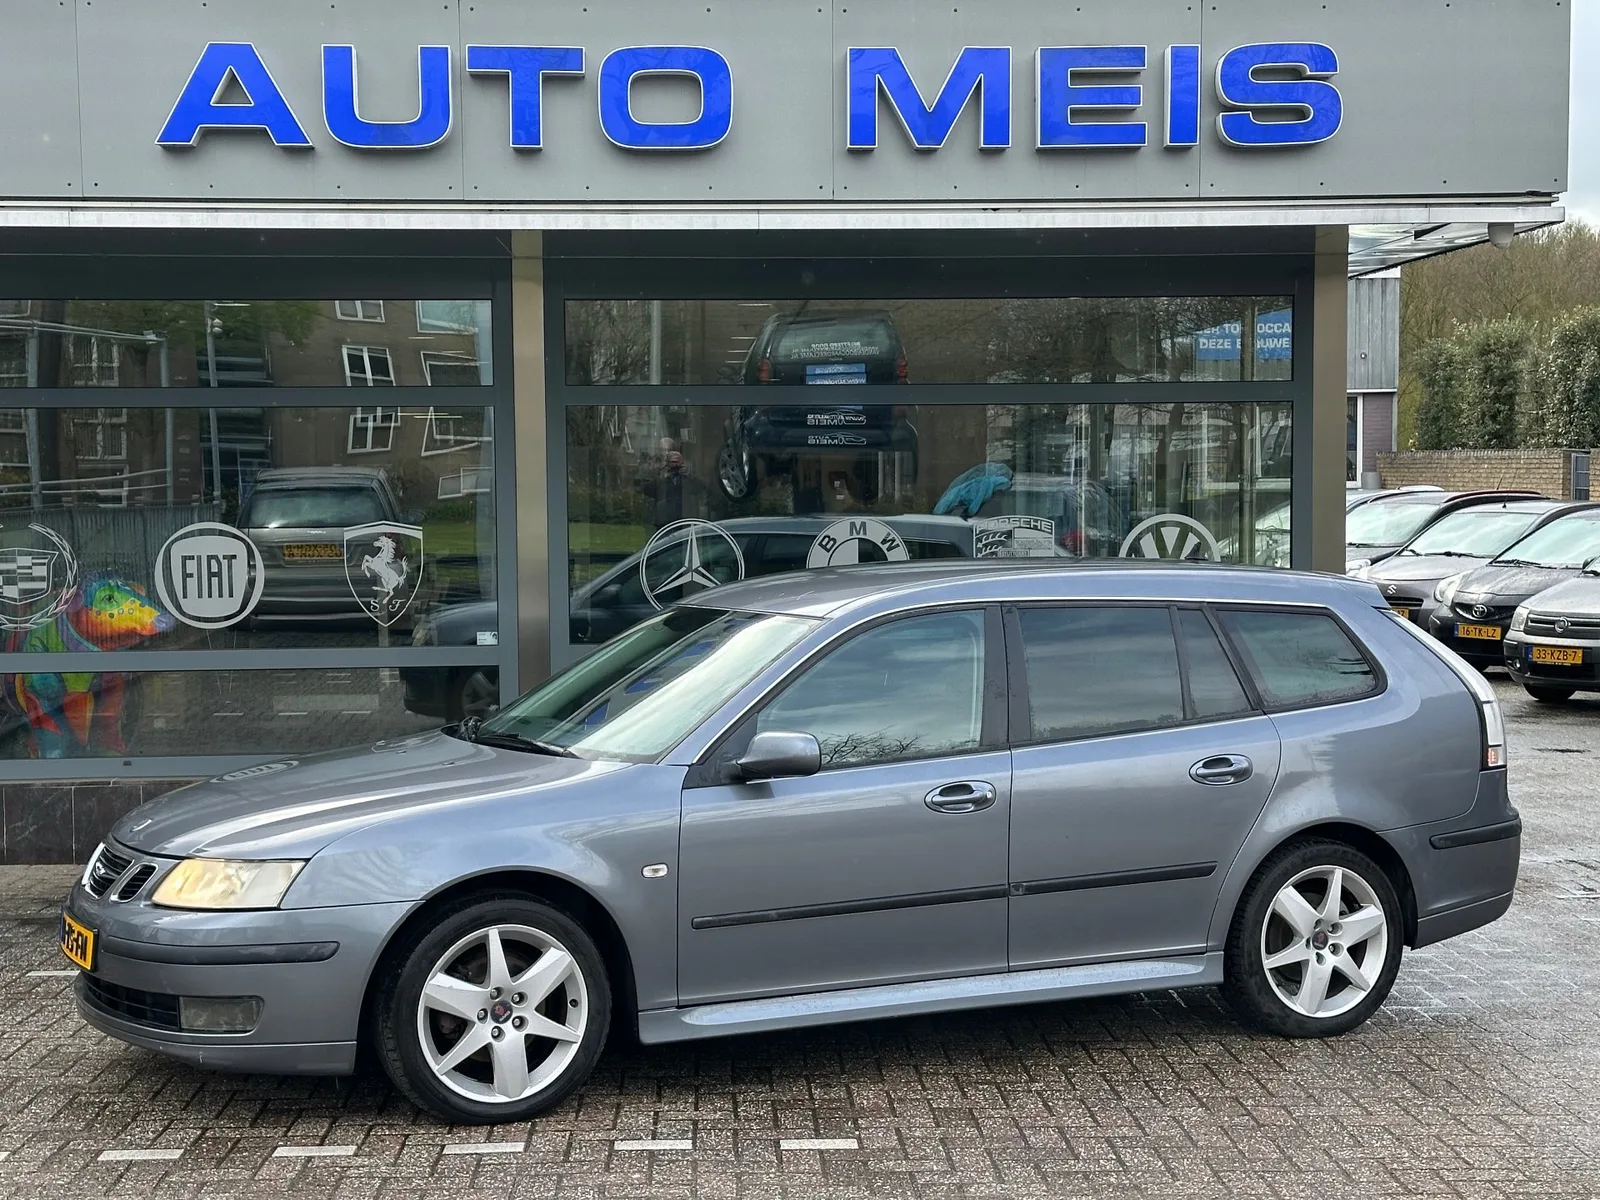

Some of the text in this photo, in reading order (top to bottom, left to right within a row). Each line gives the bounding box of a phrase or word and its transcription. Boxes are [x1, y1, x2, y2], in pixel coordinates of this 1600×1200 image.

[154, 42, 1343, 150] AUTO MEIS
[1199, 338, 1232, 349] DEZE
[976, 517, 1052, 533] PORSCHE
[818, 521, 900, 553] BMW
[180, 554, 238, 599] FIAT
[1461, 626, 1497, 638] 16-TK-LZ
[1536, 649, 1578, 661] 33-KZB-7
